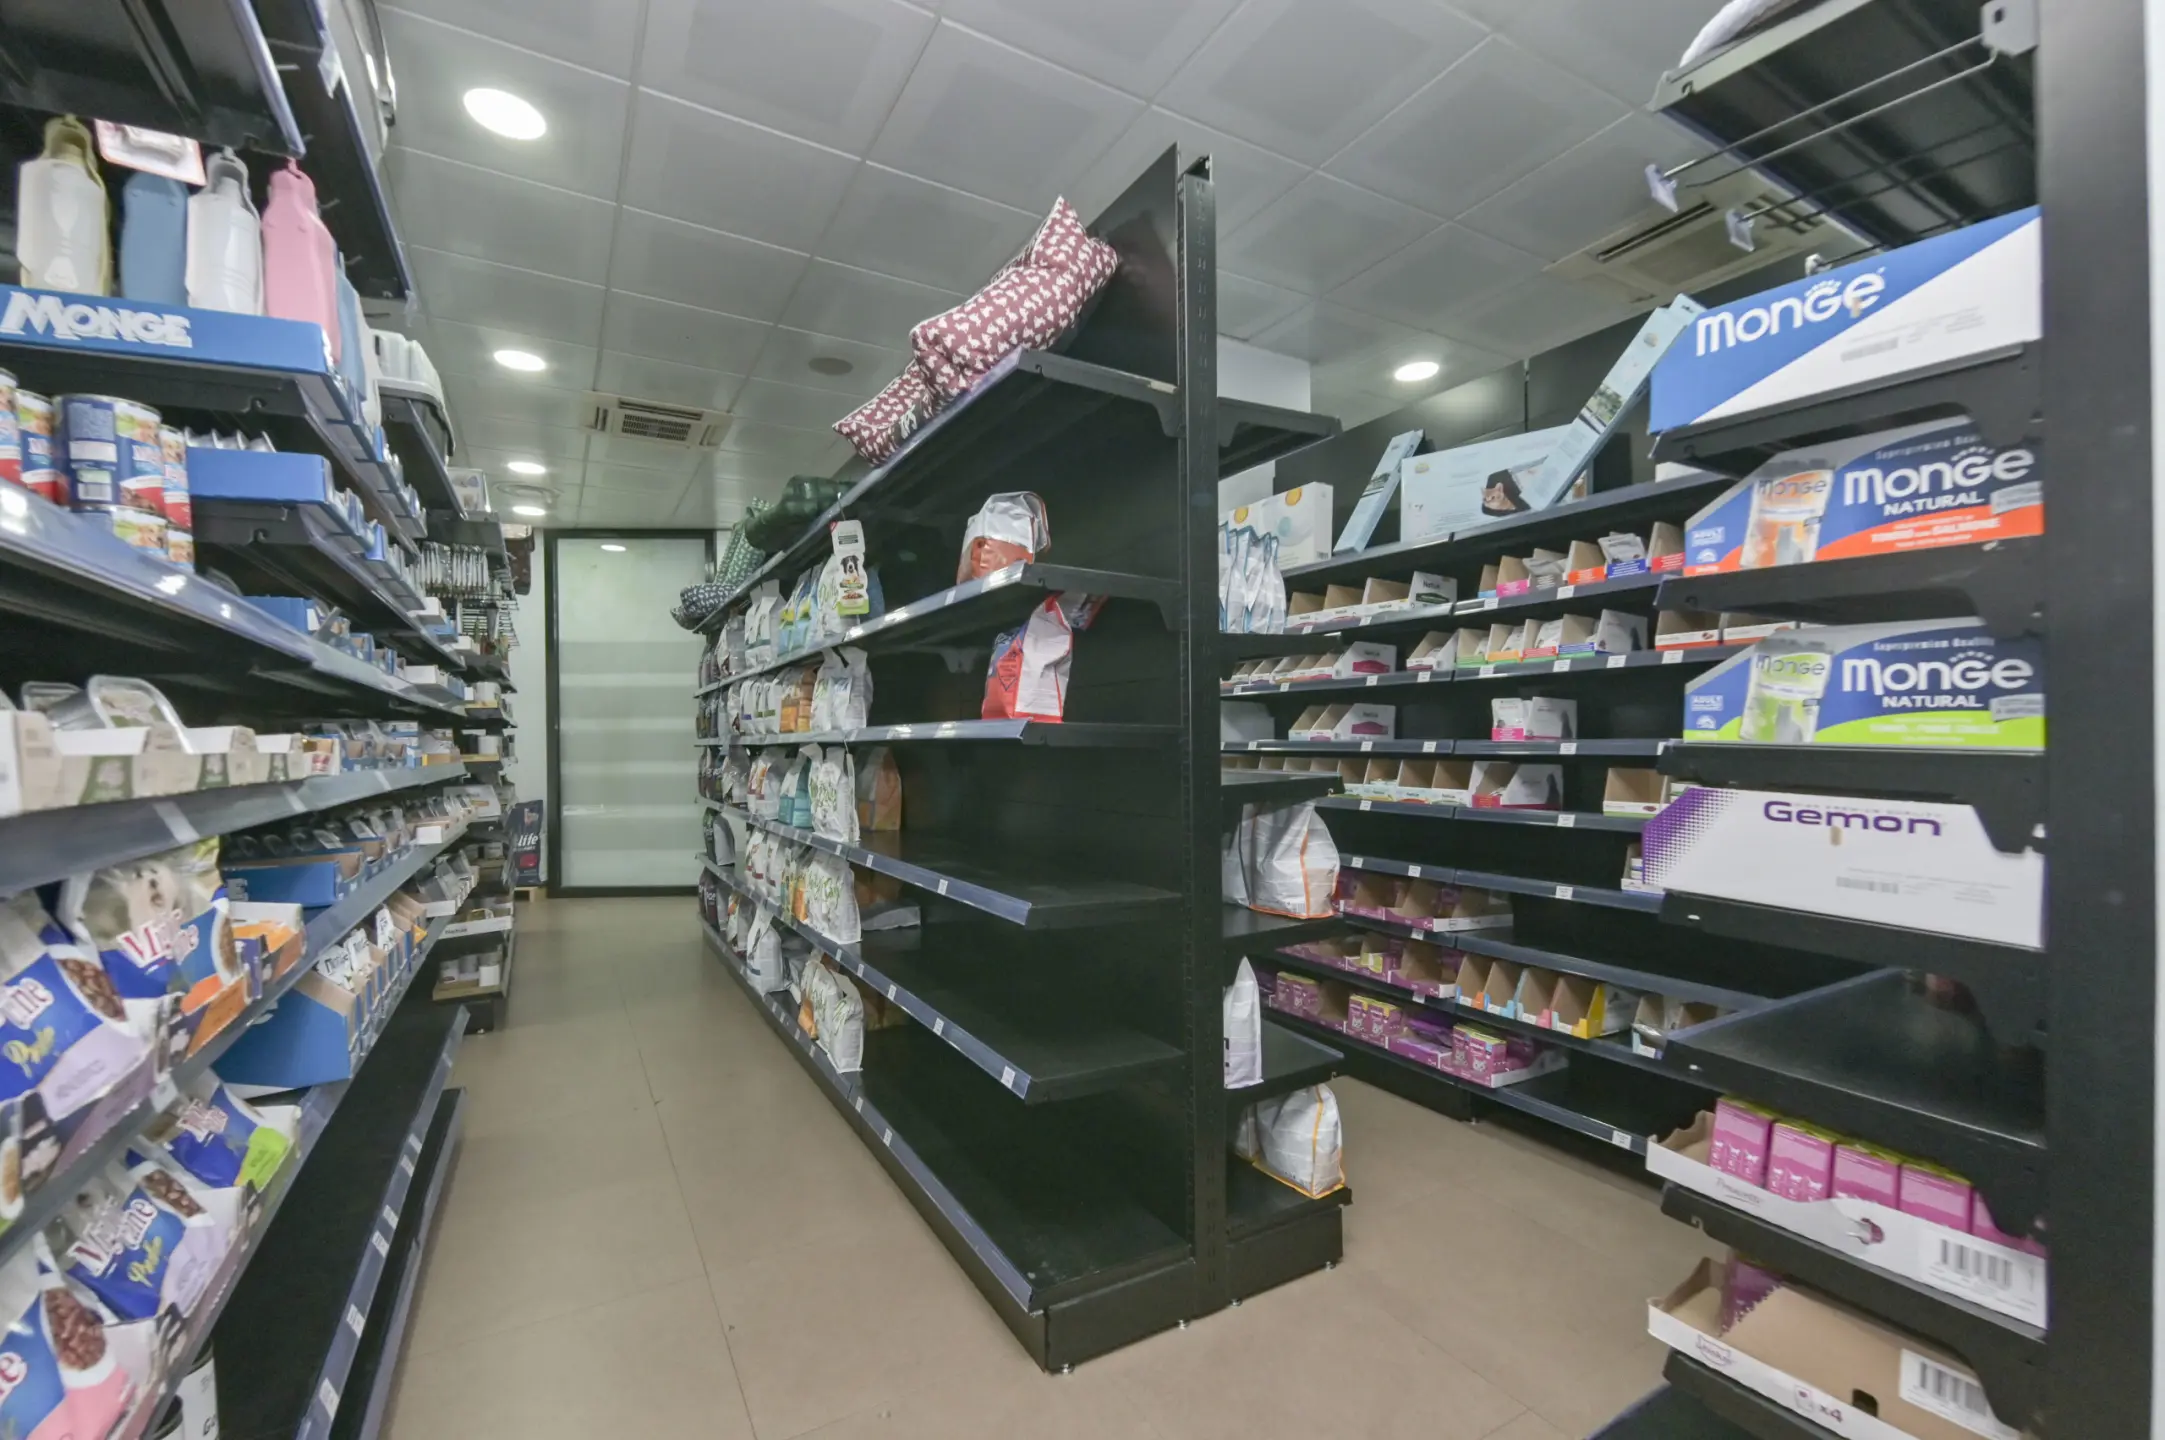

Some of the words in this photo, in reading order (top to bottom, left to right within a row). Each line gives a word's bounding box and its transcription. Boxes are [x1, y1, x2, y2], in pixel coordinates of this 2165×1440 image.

[1883, 491, 1986, 517] NATURAL
[1881, 694, 1985, 708] NATURAL
[1763, 800, 1942, 837] Gemon
[1819, 1404, 1844, 1423] x4
